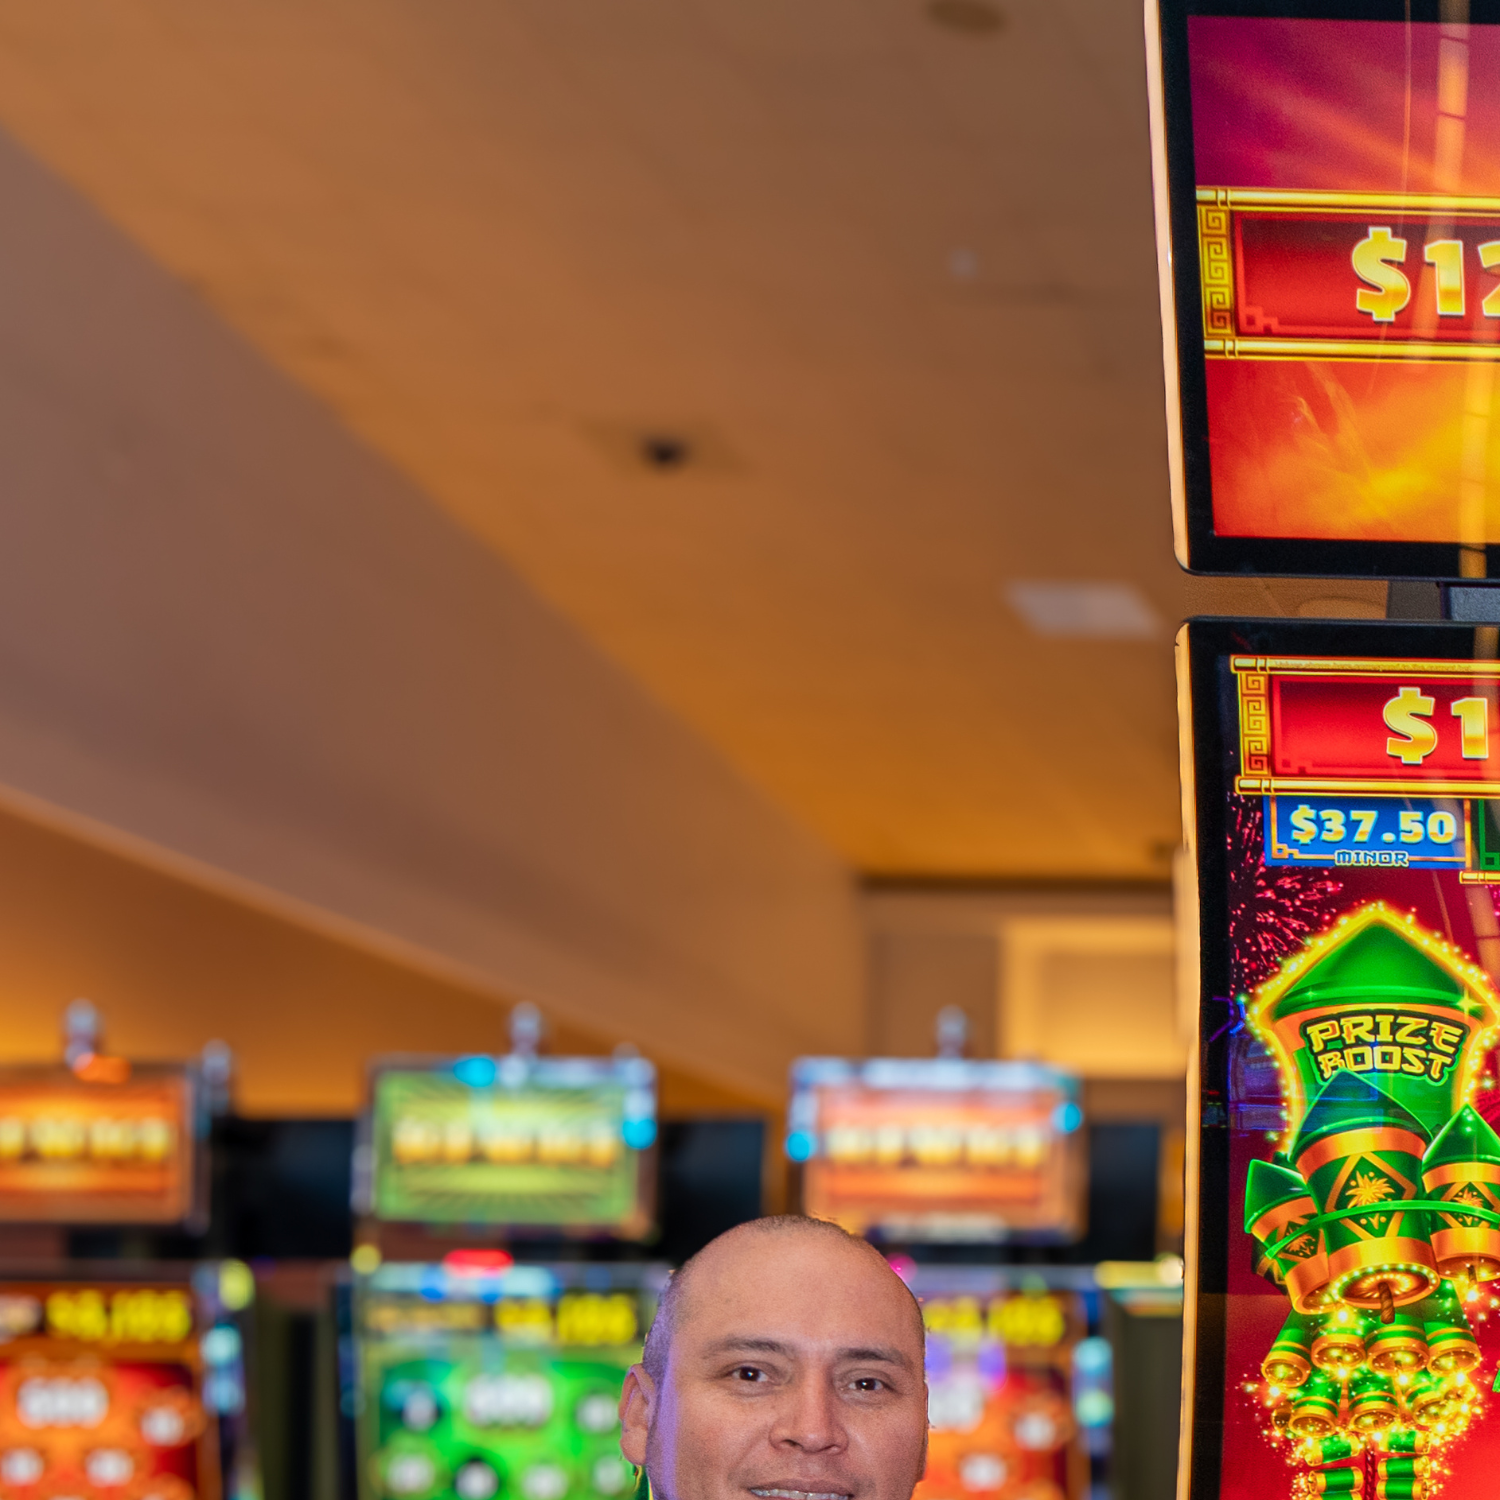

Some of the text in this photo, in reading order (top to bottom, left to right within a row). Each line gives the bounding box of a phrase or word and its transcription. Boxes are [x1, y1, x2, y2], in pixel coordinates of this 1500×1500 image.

[1290, 805, 1457, 846] $37.50
[1335, 849, 1410, 868] MINOR
[1306, 1014, 1464, 1054] PRIZE
[1317, 1046, 1453, 1080] BOOST
